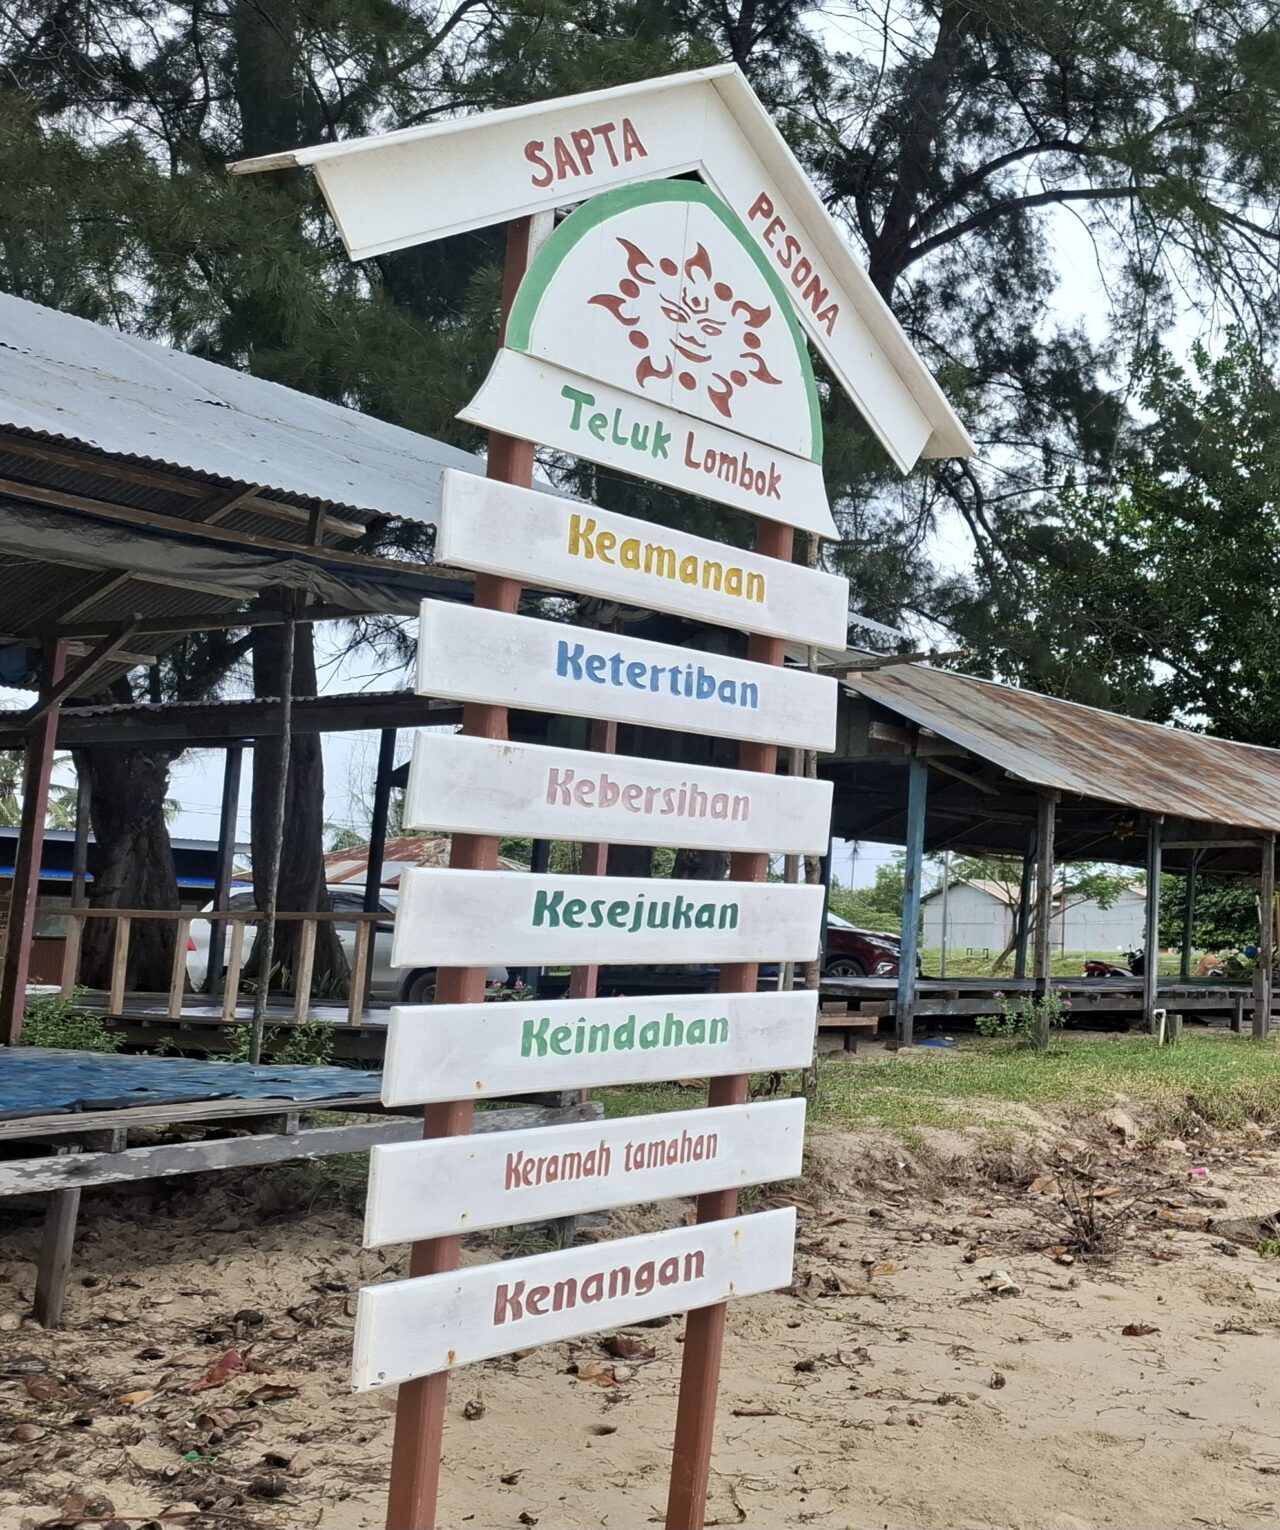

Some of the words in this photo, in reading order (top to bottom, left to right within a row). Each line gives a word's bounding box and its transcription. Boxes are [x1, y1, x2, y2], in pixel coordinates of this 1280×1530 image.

[524, 117, 648, 188] SAPTA
[749, 191, 840, 337] PESONA
[684, 431, 782, 500] Lombok
[568, 514, 766, 603] Keamanan
[556, 640, 759, 708] Ketertiban
[545, 767, 751, 821] Kebersihan
[532, 890, 739, 933] Kesejukan
[520, 1012, 729, 1058] Keindahan
[504, 1139, 611, 1191] Keramah
[624, 1129, 718, 1172] tamahan
[493, 1248, 705, 1326] Kenangan
